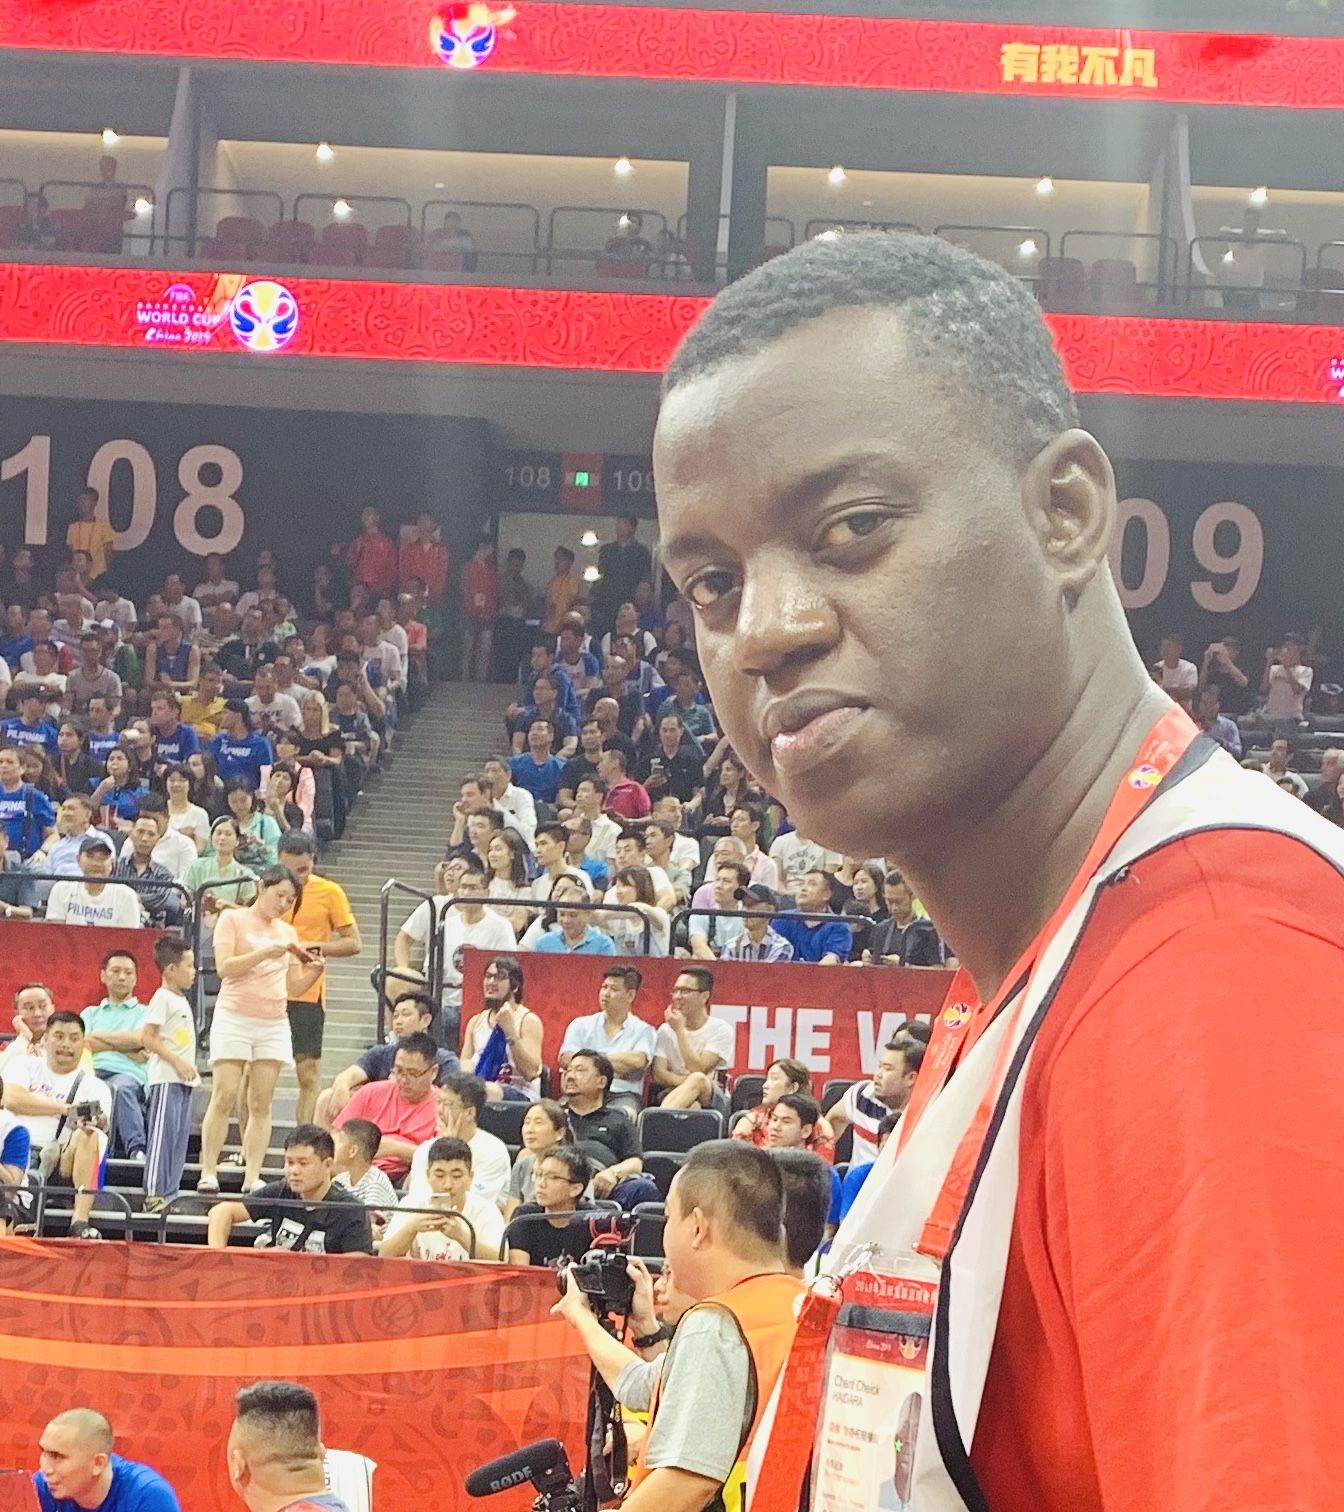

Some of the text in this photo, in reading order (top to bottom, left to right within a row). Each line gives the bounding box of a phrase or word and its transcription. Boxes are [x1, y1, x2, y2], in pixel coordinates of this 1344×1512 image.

[1001, 42, 1158, 87] 有我不凡
[136, 310, 221, 327] WORLD CUP
[1, 435, 245, 556] 108
[506, 466, 552, 489] 108
[1107, 497, 1265, 613] 09
[67, 902, 114, 920] PILIPINAS
[710, 1004, 834, 1073] THE
